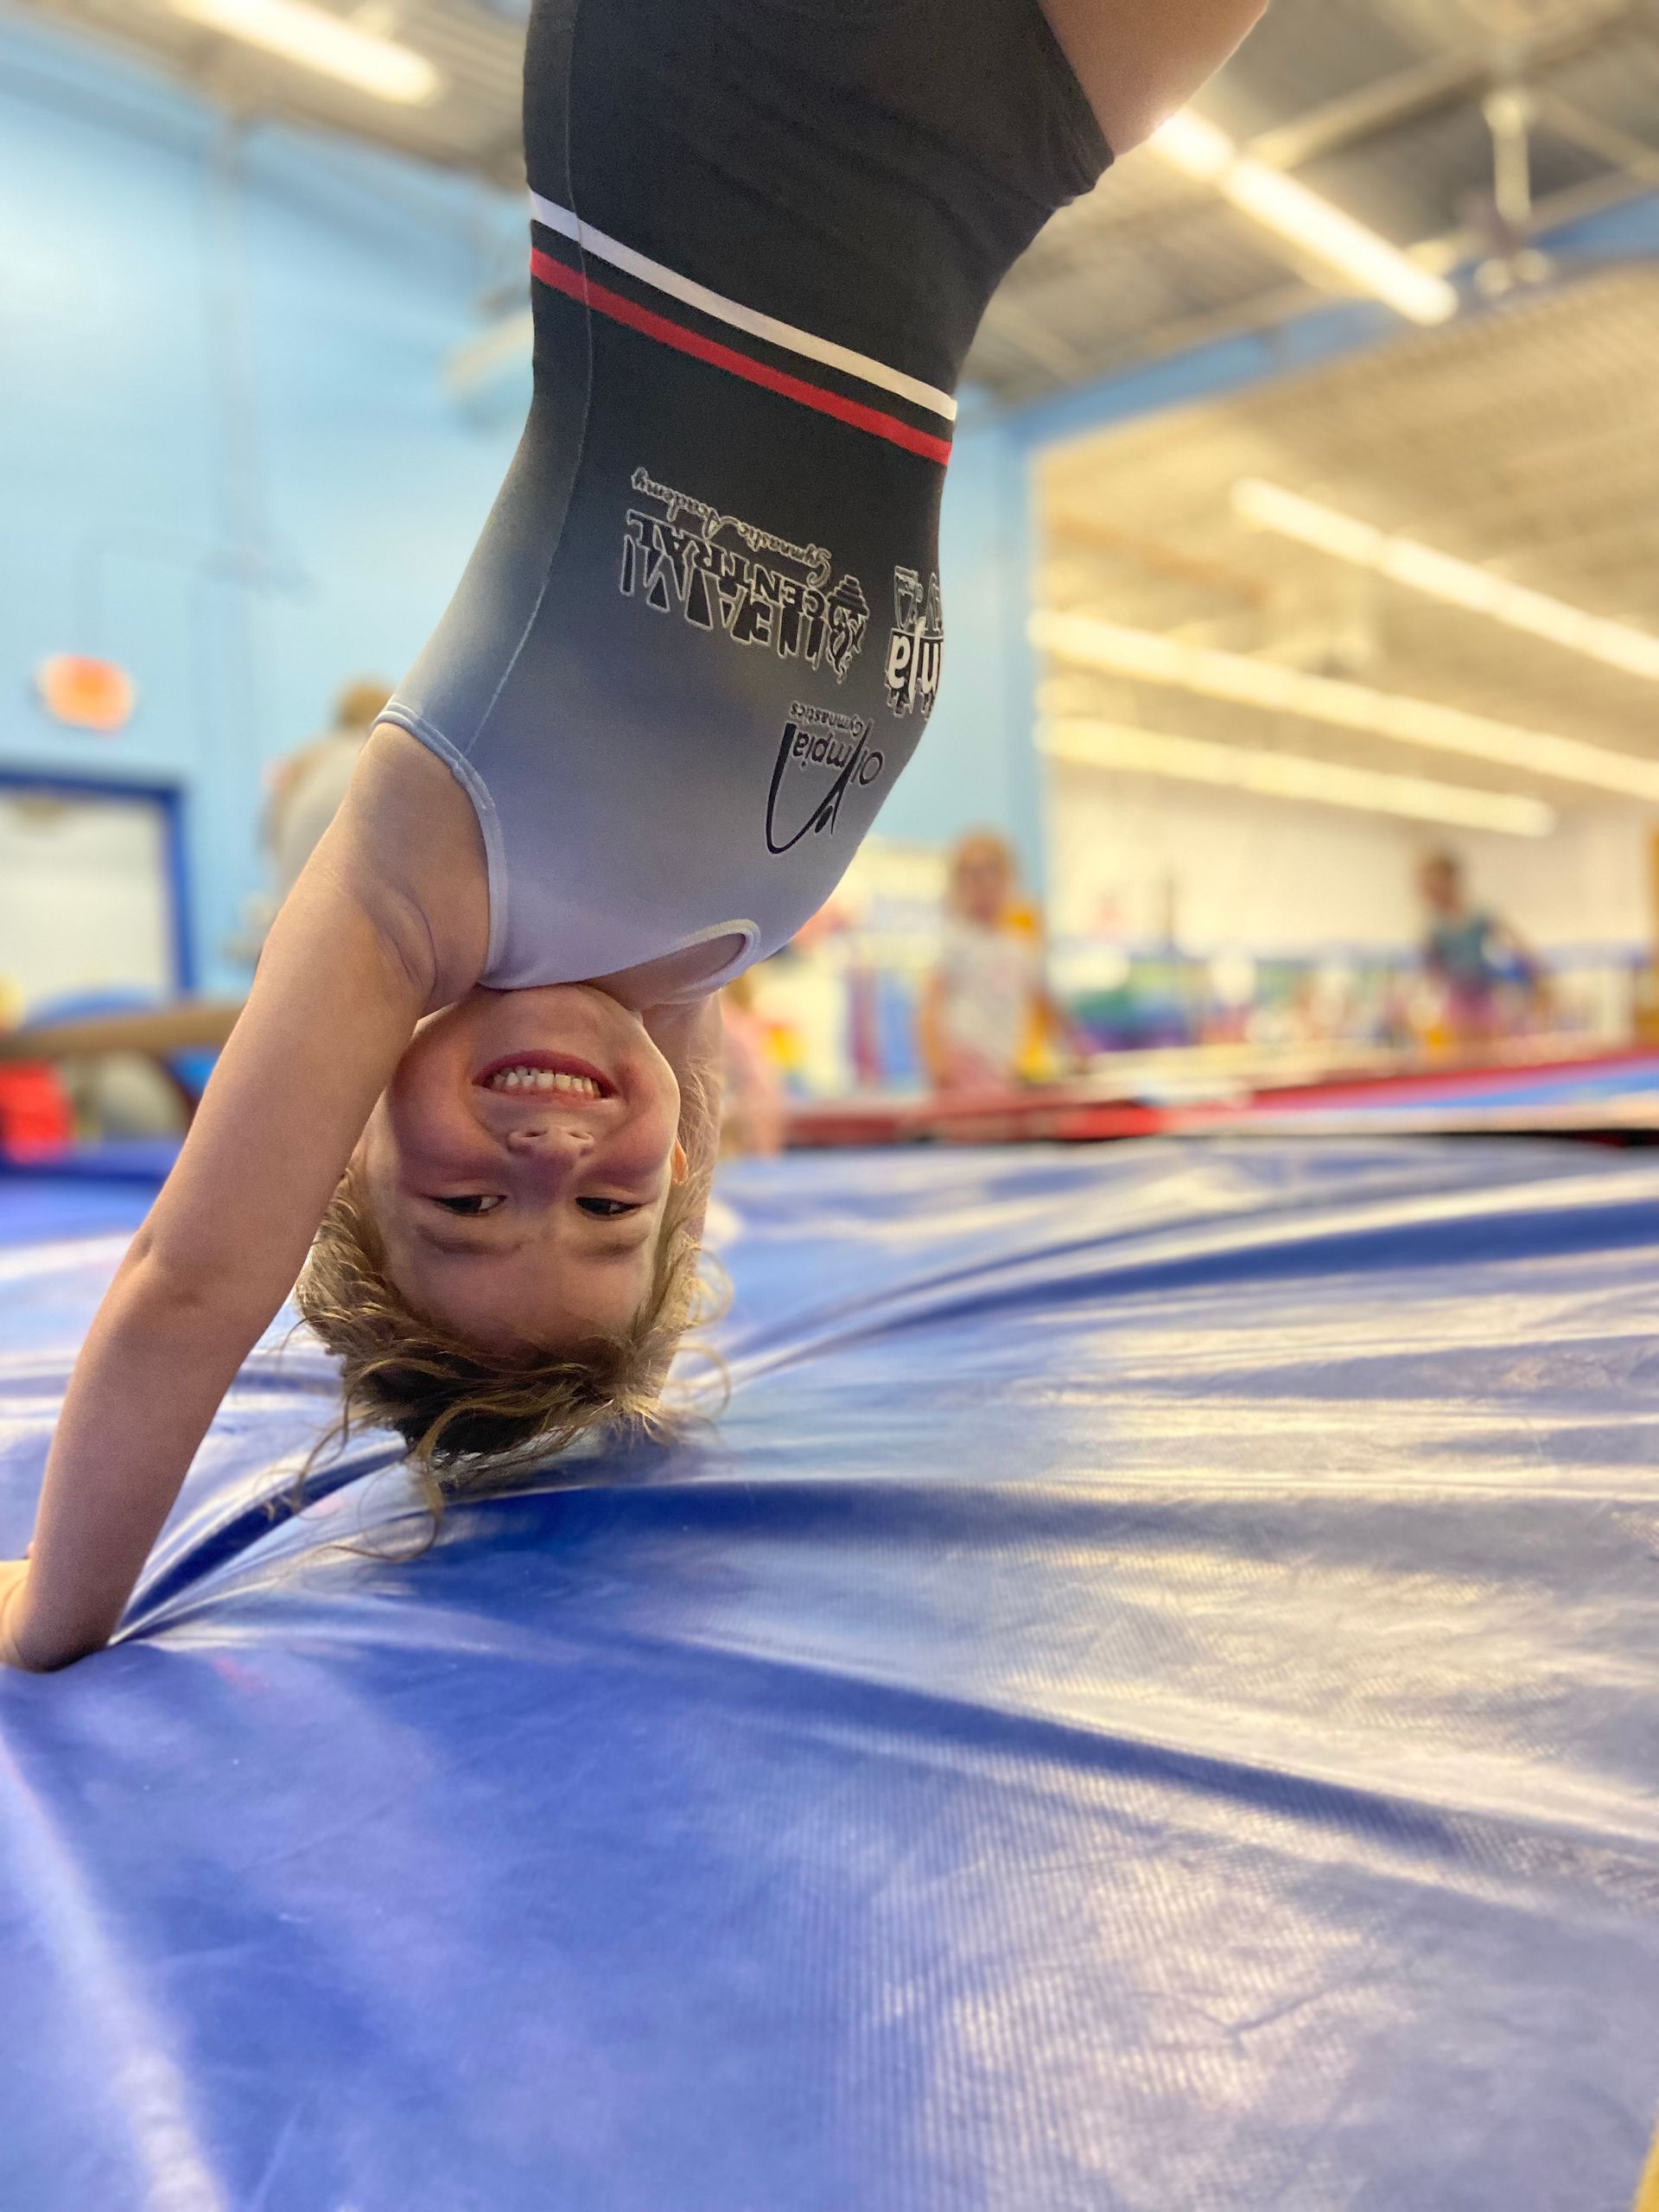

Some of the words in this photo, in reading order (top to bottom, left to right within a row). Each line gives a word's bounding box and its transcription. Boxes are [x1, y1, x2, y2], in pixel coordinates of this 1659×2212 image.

[632, 467, 738, 541] Academy
[626, 509, 827, 620] CENTRAL
[789, 701, 864, 737] Gymnastics
